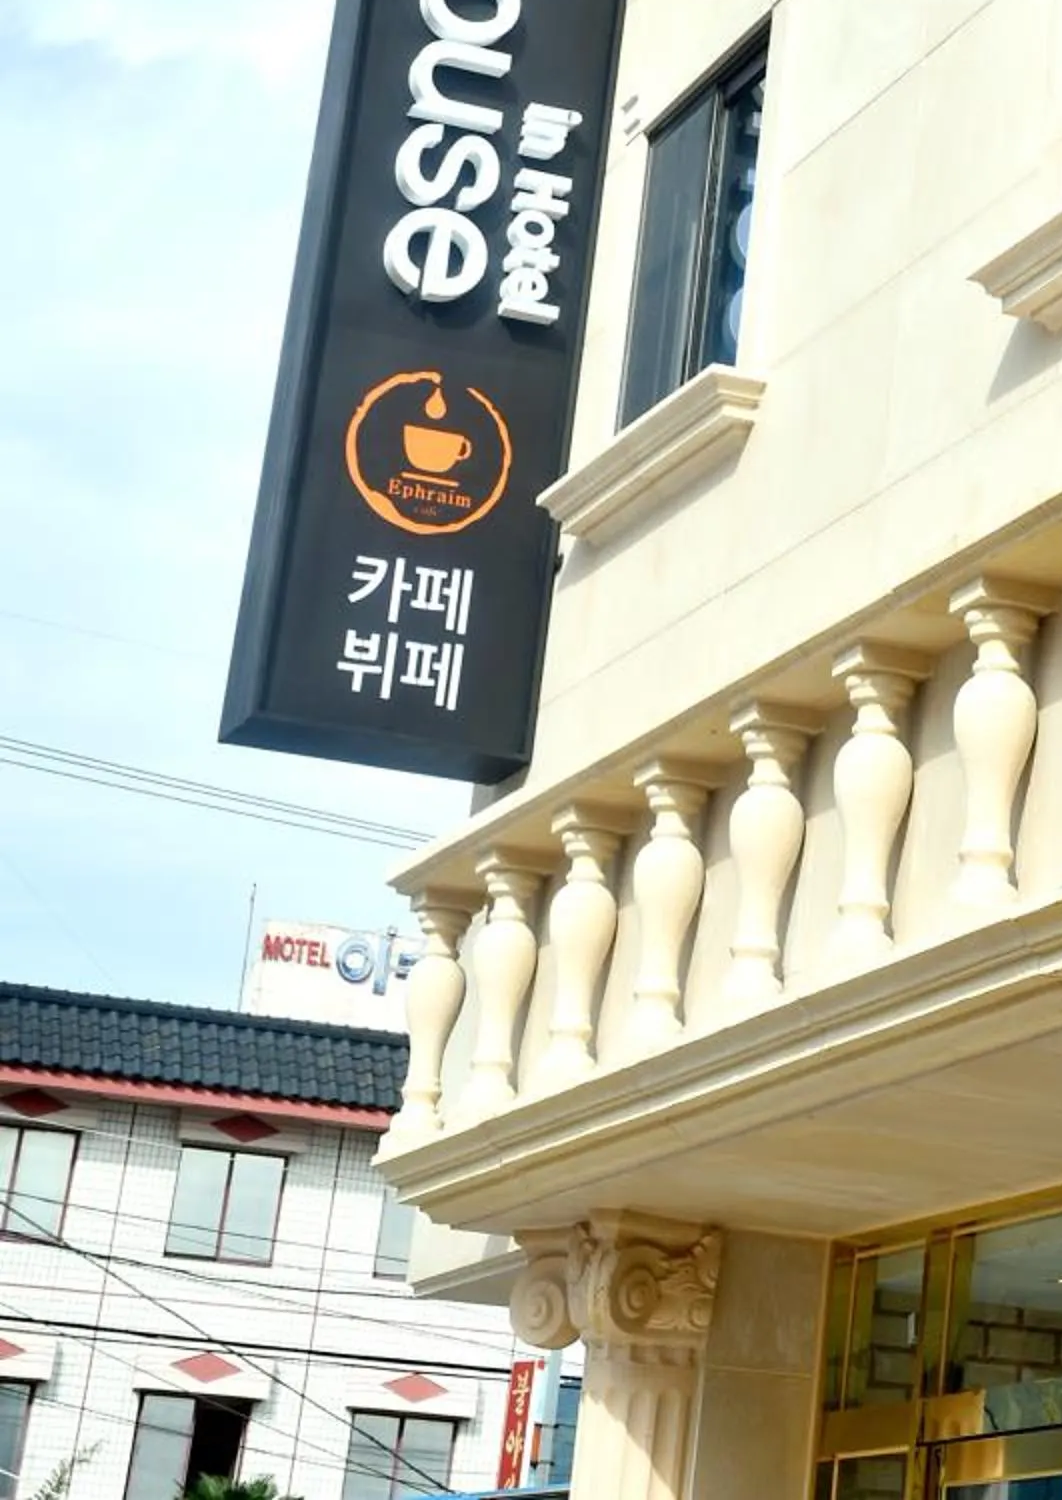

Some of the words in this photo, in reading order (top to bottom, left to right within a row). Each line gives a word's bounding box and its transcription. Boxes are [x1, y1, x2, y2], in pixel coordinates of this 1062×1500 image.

[517, 102, 583, 161] in
[497, 167, 573, 325] Hotel
[387, 477, 472, 509] Ephraim
[346, 554, 475, 636] 카페
[336, 628, 465, 712] 뷔페
[261, 932, 332, 969] MOTEL
